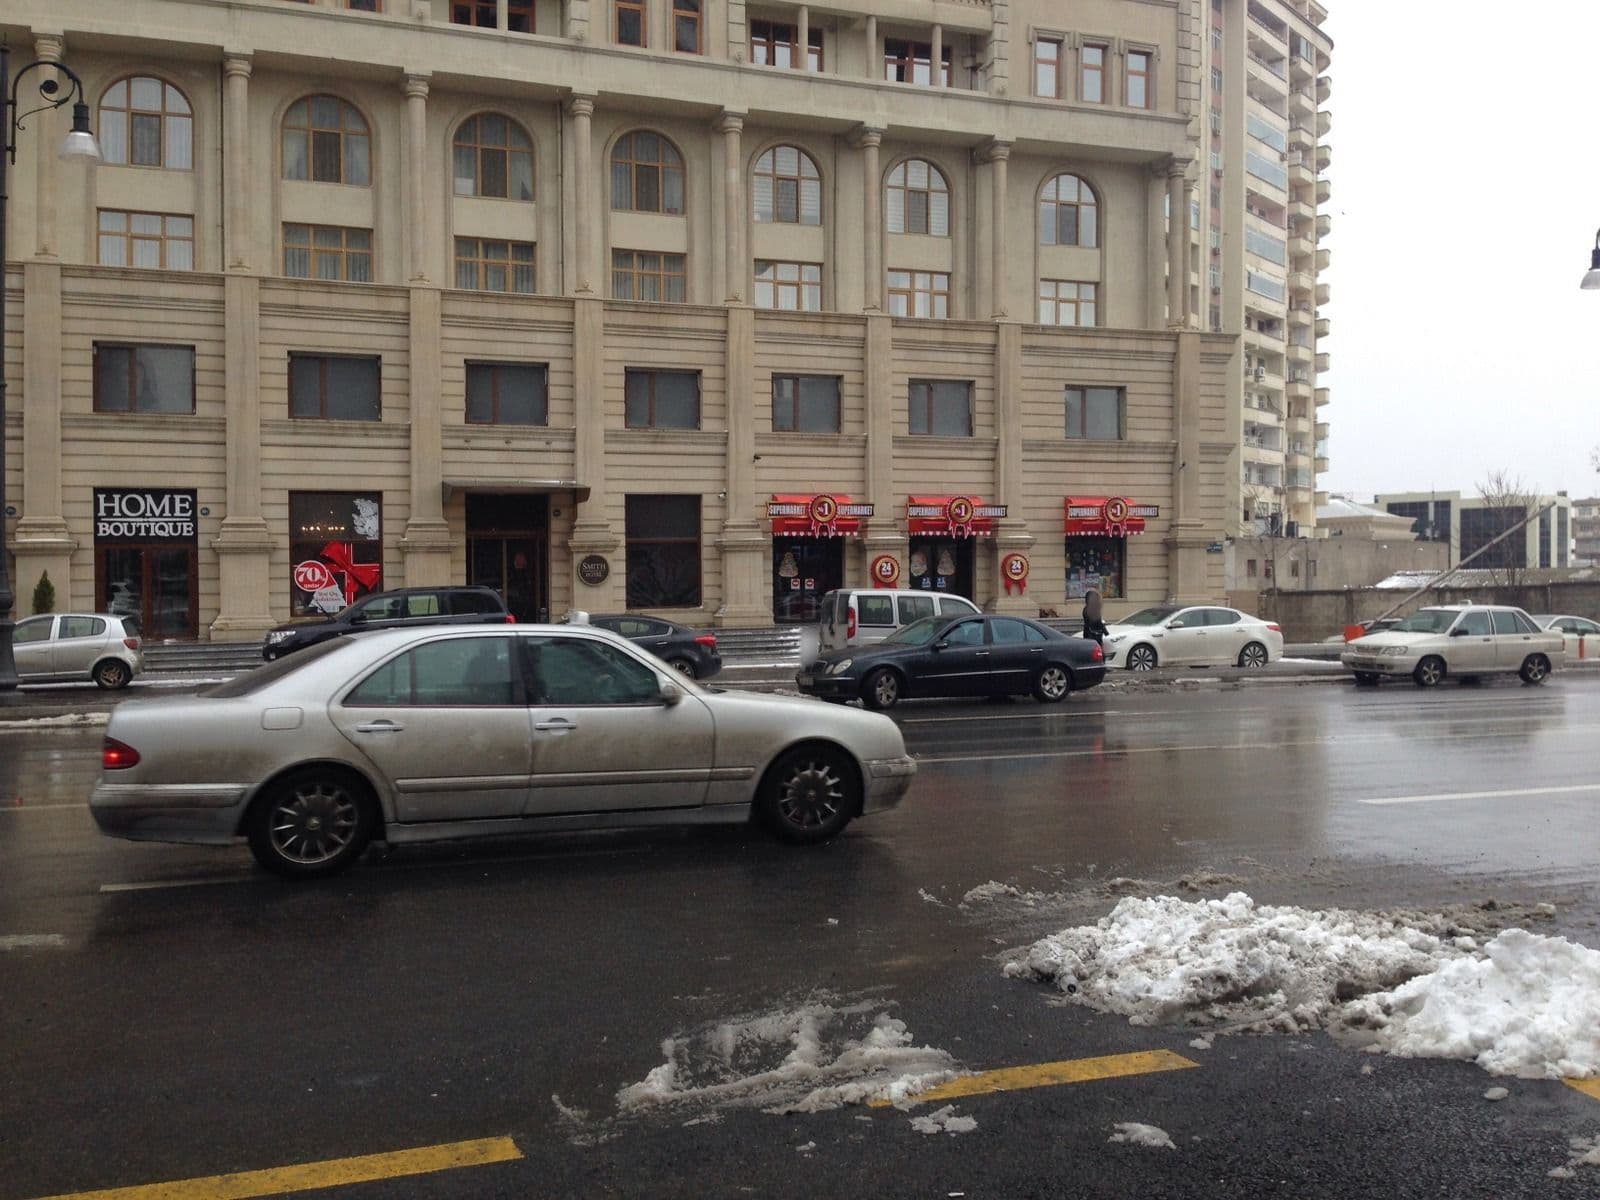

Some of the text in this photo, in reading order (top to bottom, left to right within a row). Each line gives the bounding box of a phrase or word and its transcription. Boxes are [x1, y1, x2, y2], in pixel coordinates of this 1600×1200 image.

[97, 494, 192, 517] HOME
[768, 504, 806, 516] SUPERMARKET
[838, 504, 873, 516] SUPERMARKET
[908, 506, 943, 517] SUPERMARKET
[974, 506, 1005, 517] SUPERMARKET
[1070, 507, 1100, 517] SUPERMARKET
[1127, 507, 1158, 516] SUPERMARKET
[97, 522, 194, 537] BOUTIQUE
[881, 562, 892, 572] 24
[1011, 560, 1022, 570] 24
